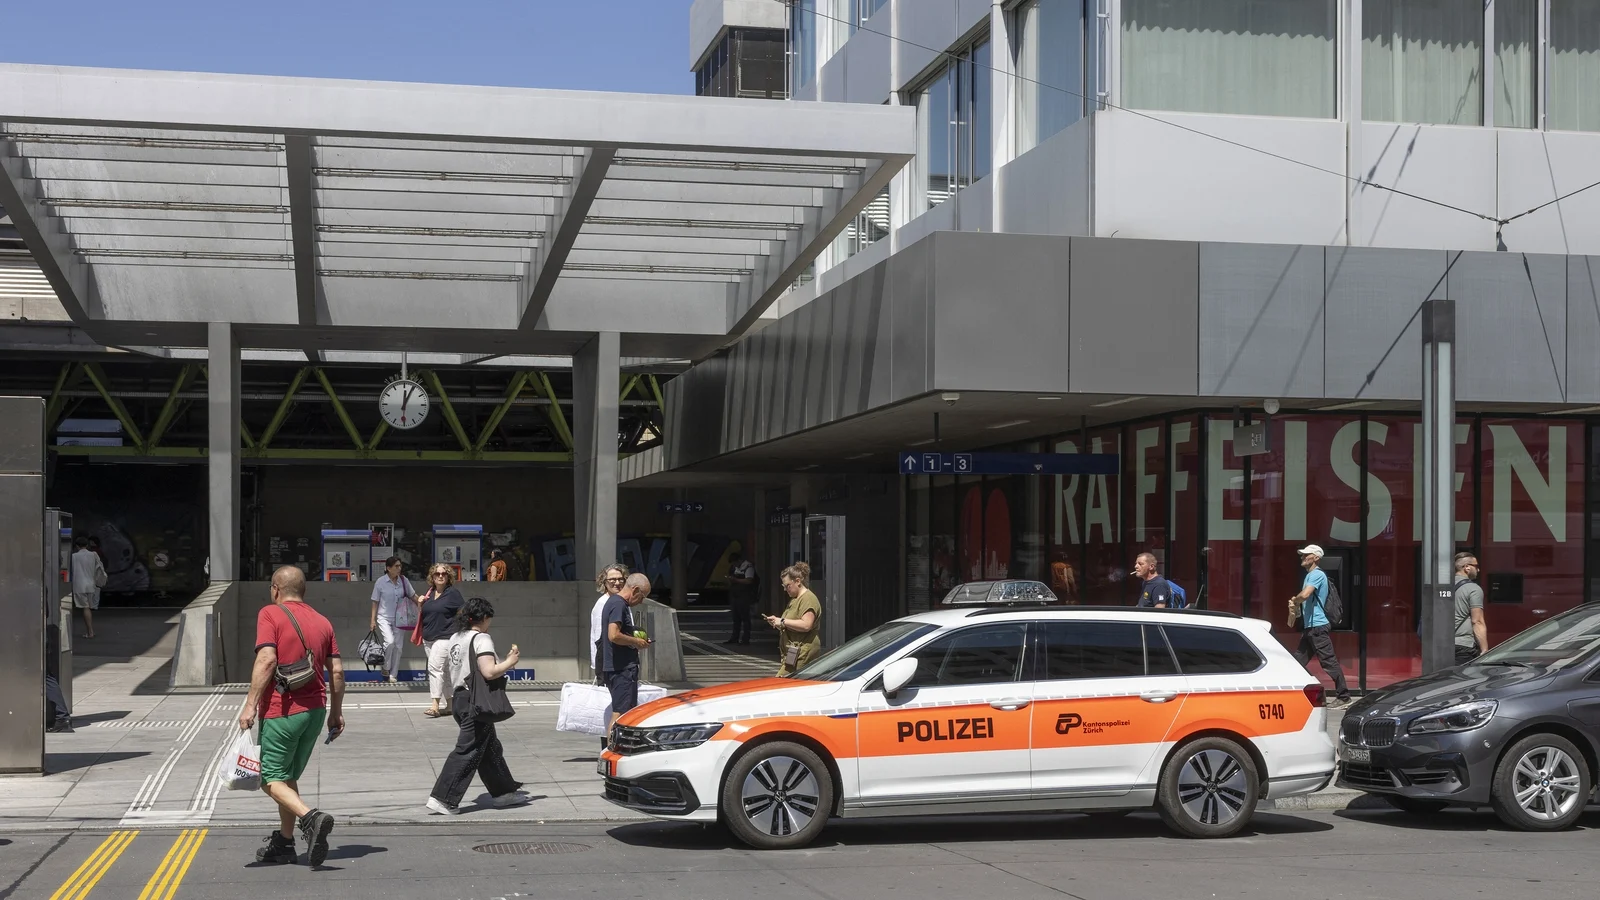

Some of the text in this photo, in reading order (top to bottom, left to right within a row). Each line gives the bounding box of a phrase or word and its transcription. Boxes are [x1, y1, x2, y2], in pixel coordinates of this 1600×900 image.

[928, 459, 934, 470] 1
[959, 459, 967, 470] 3
[1258, 703, 1285, 720] 6740
[897, 717, 994, 743] POLIZEI
[1082, 719, 1131, 728] Kantonspolizei
